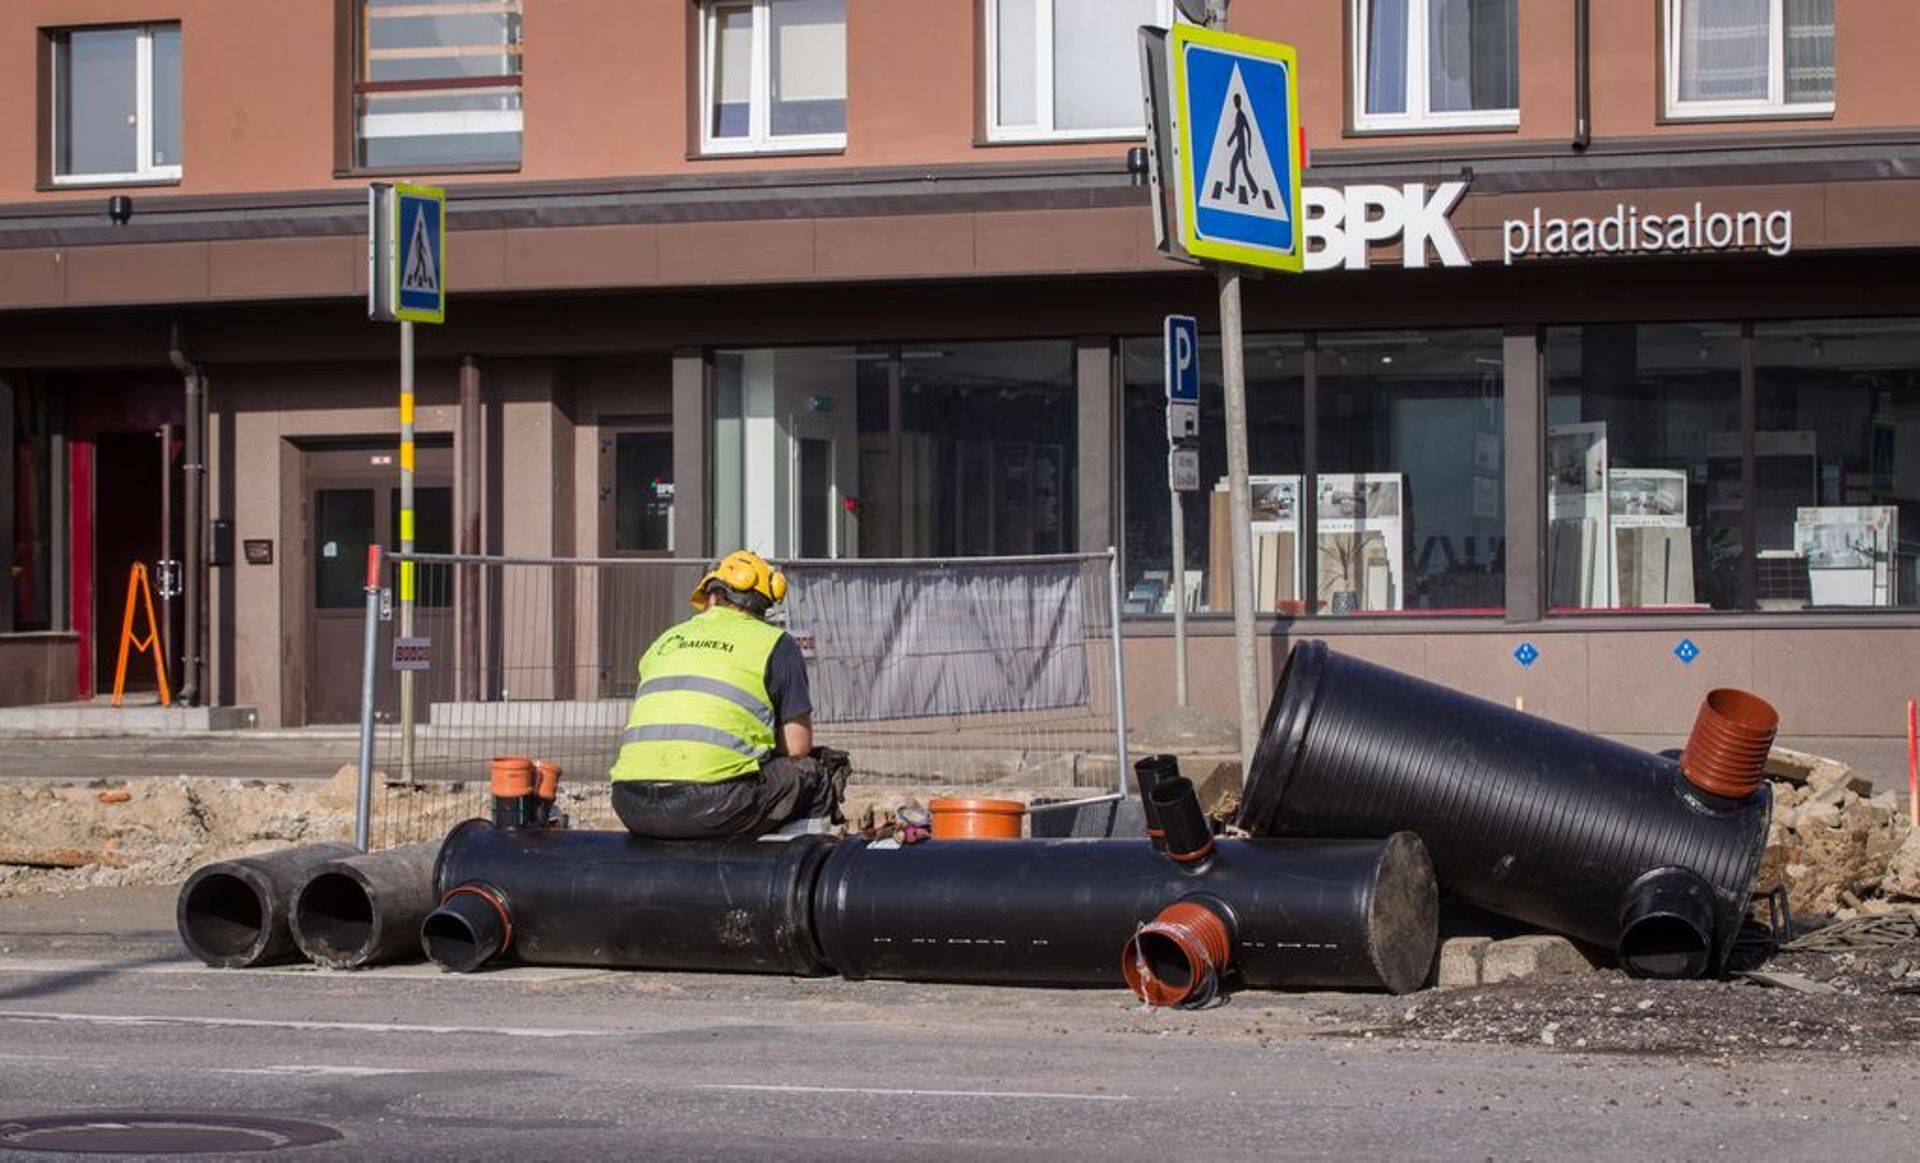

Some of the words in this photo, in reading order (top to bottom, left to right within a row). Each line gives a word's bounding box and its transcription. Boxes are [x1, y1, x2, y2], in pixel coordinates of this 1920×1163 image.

[1302, 182, 1471, 270] BPK
[1503, 201, 1792, 264] plaadisalong
[1175, 327, 1191, 391] P
